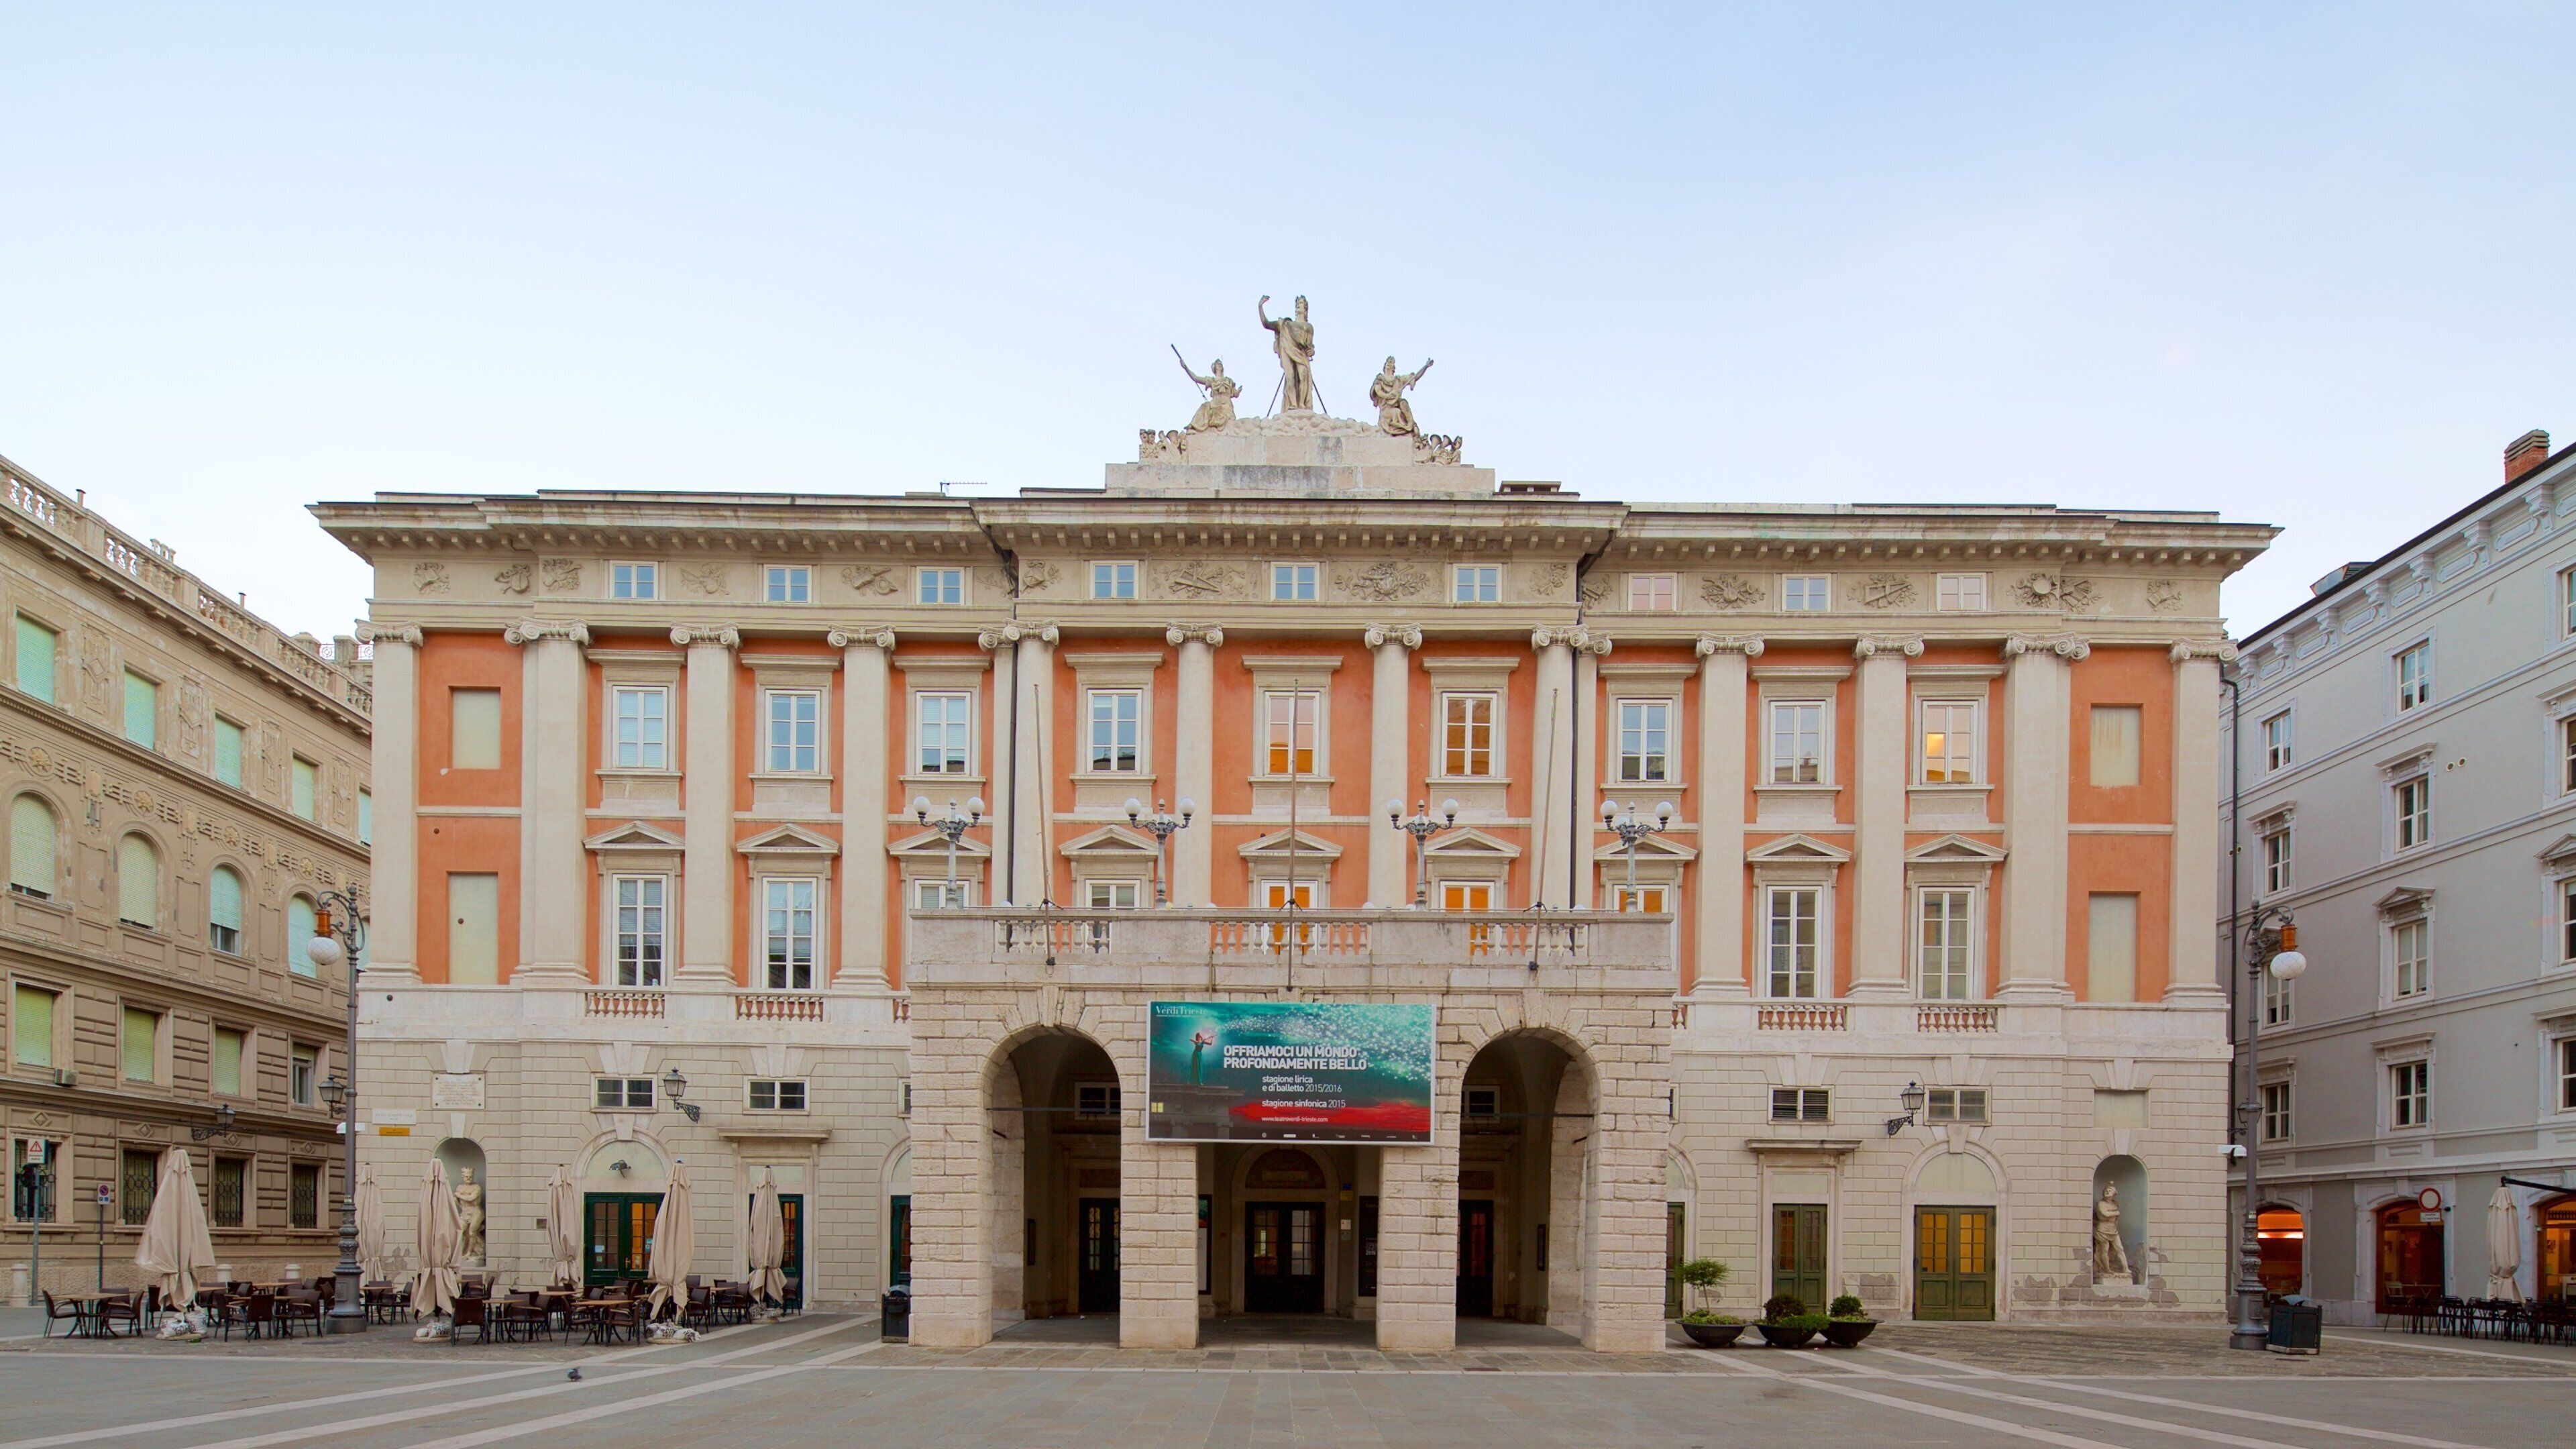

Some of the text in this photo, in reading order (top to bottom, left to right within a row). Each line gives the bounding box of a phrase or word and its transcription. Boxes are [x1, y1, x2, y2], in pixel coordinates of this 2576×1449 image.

[1224, 1045, 1358, 1058] OFFRIAMOCI UN MONDO
[1224, 1057, 1367, 1071] PROFONDAMENTE BELLO
[1262, 1075, 1313, 1085] stagione lirica
[1268, 1084, 1275, 1092] di
[1277, 1084, 1305, 1092] balletto
[1305, 1083, 1342, 1093] 2015/2016
[1262, 1099, 1346, 1109] stagione sinfonica 2015
